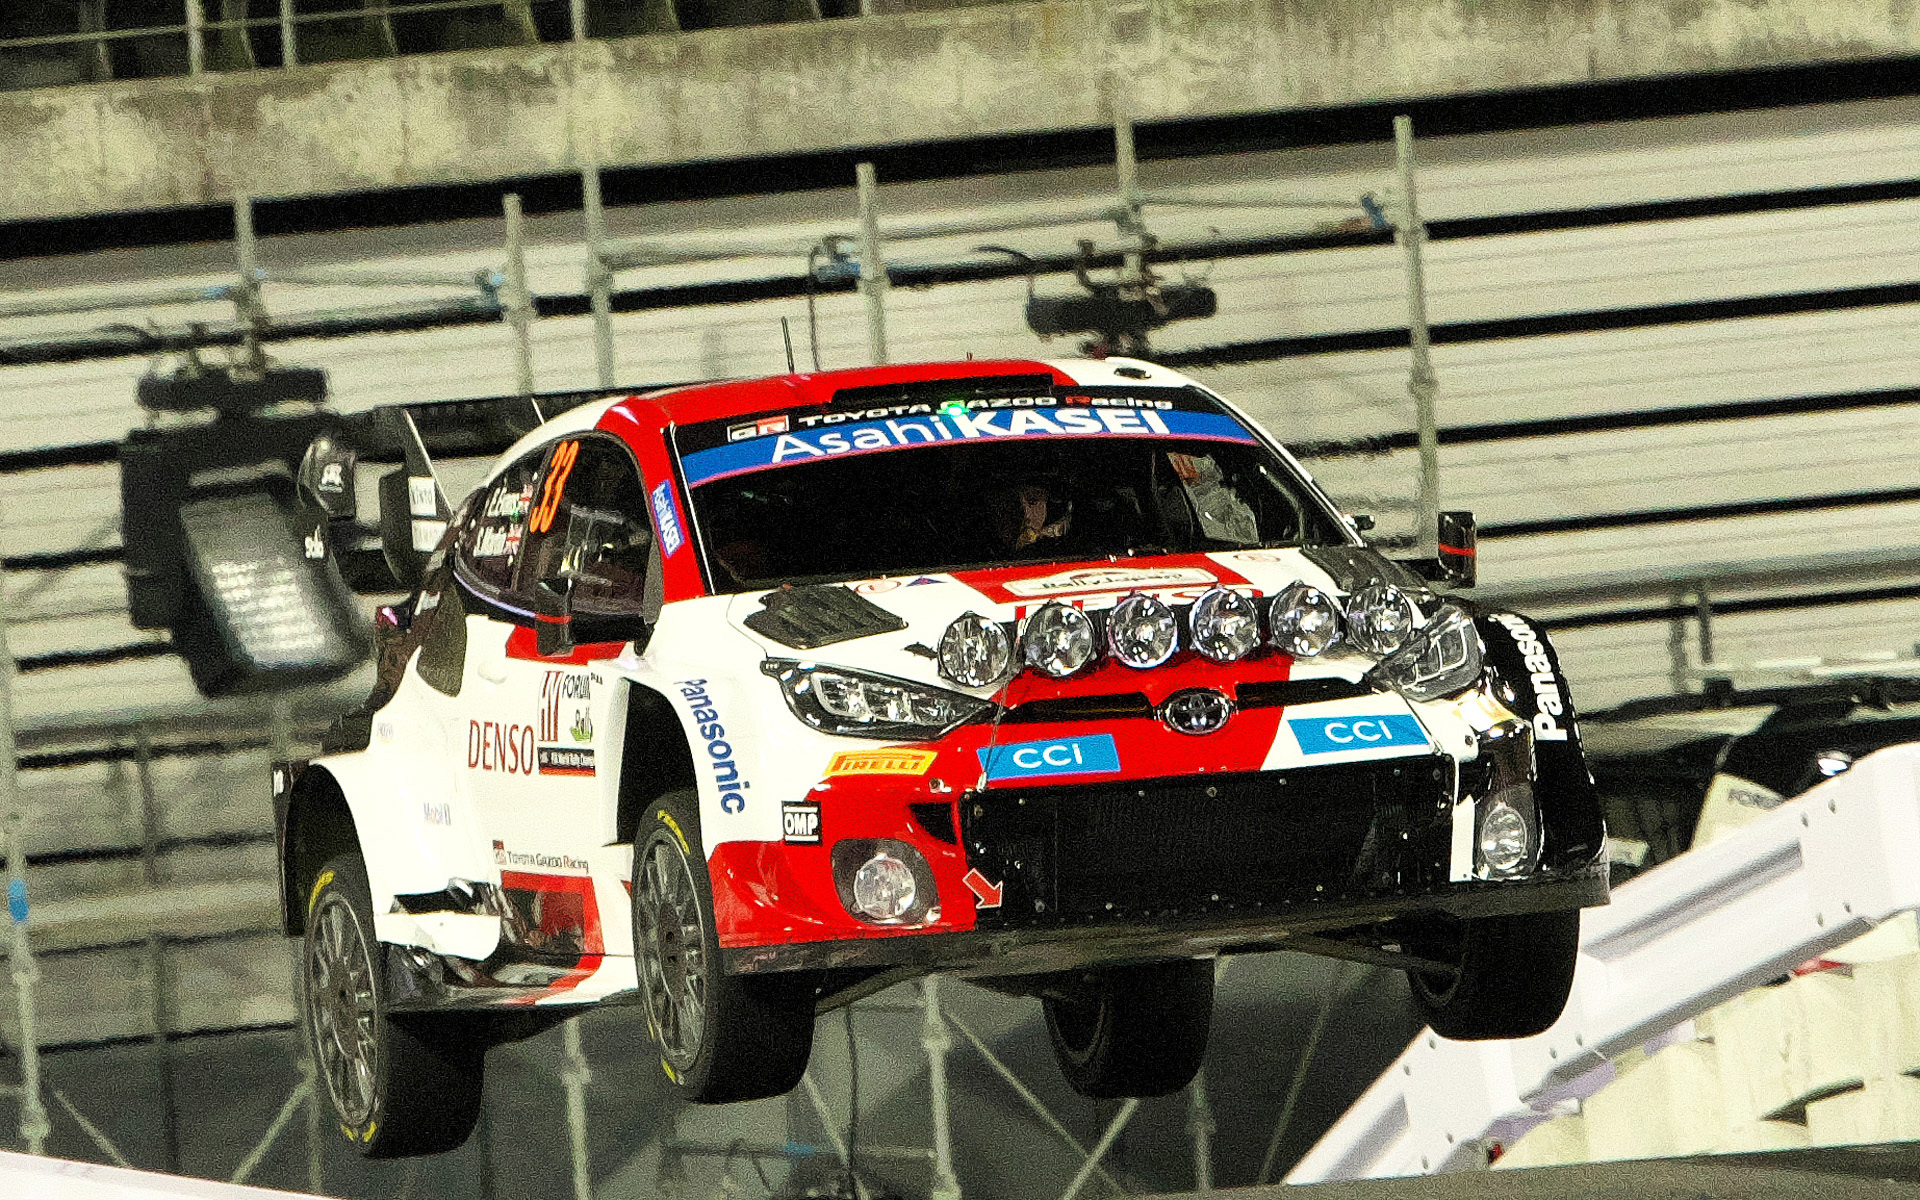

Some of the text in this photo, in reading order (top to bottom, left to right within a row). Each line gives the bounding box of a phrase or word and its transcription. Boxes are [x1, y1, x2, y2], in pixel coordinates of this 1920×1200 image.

[798, 403, 933, 427] TOYOTA
[1065, 395, 1173, 410] Racing
[529, 440, 581, 534] 33
[1487, 613, 1569, 742] Panason
[467, 719, 535, 776] DENSO
[673, 678, 751, 814] Panasonic
[1324, 720, 1393, 744] CCI
[831, 752, 926, 773] PIRELLI
[1012, 743, 1083, 769] CCI
[784, 812, 819, 836] OMP
